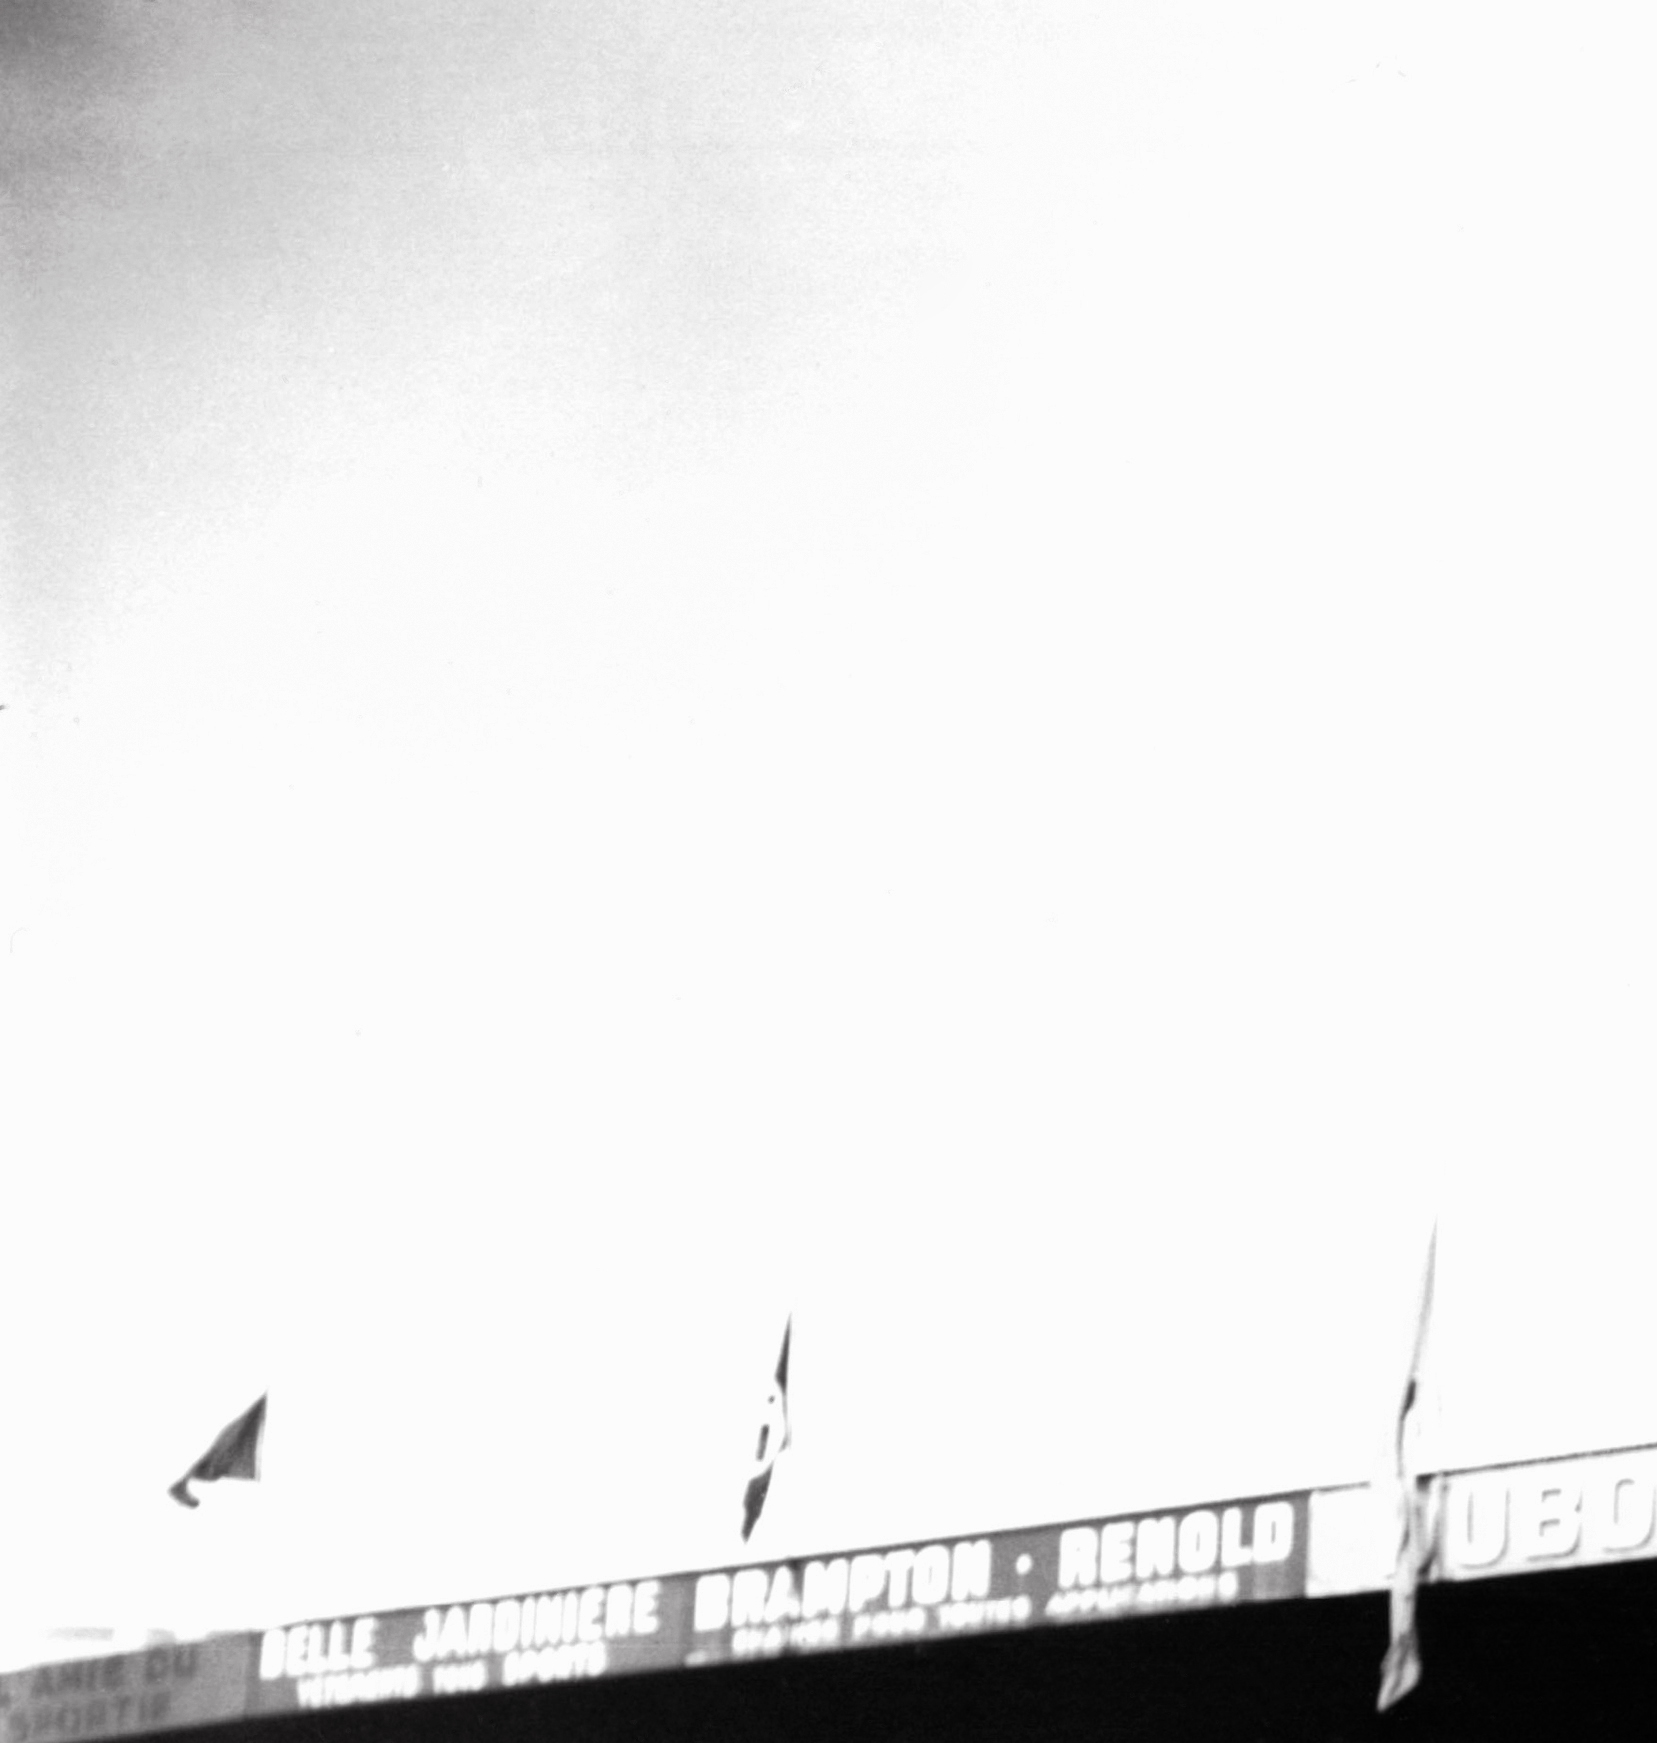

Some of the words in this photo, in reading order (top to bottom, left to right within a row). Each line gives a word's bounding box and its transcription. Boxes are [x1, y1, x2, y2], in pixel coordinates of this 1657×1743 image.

[694, 1539, 991, 1633] BRAMPTON
[1058, 1501, 1294, 1589] RENOLD
[259, 1616, 378, 1681] BELLE
